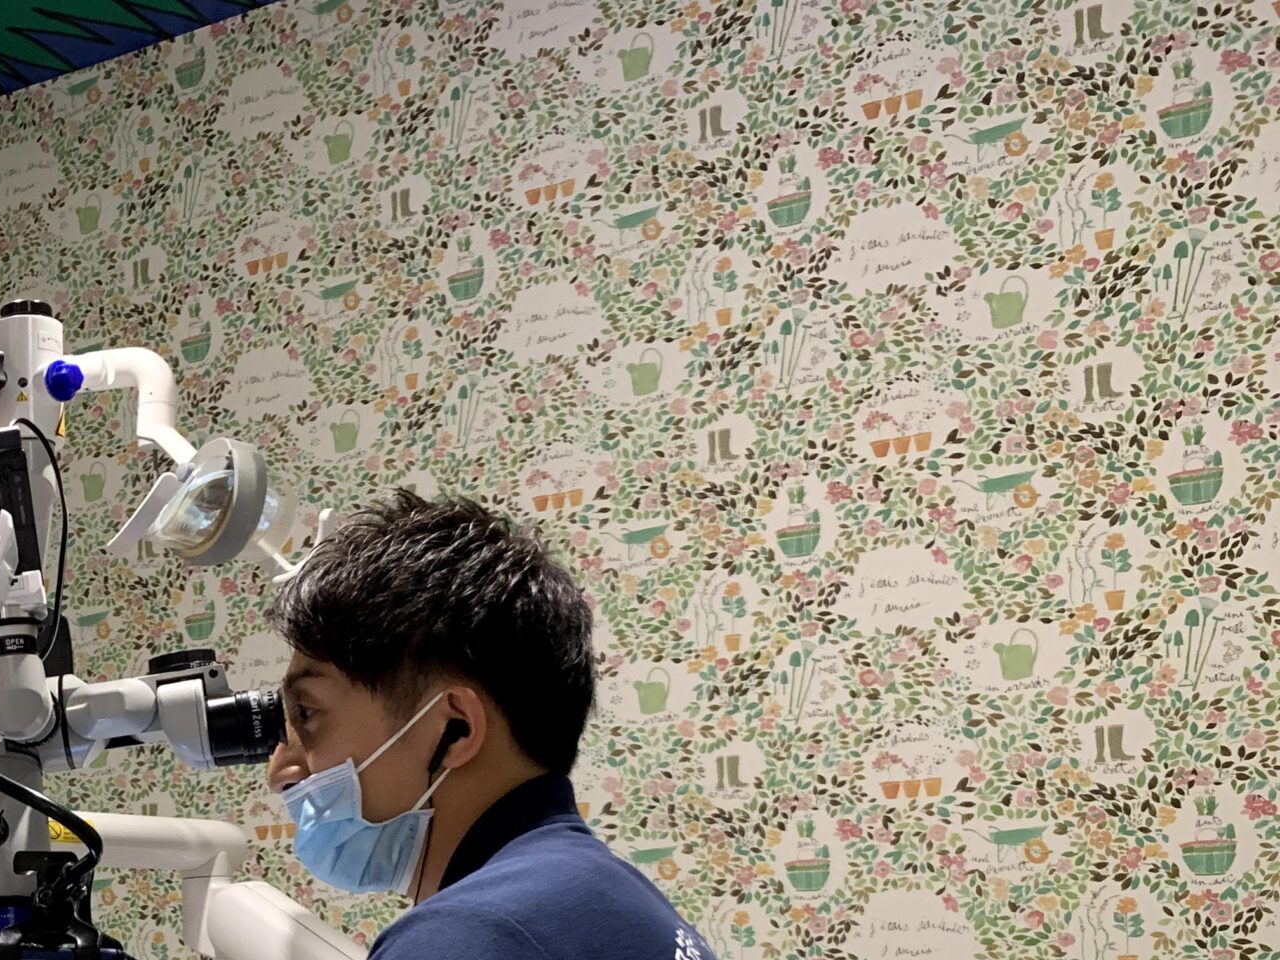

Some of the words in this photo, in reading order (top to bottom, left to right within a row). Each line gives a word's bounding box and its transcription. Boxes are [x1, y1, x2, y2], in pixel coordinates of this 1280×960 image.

[5, 637, 24, 646] OPEN
[249, 695, 261, 712] Carl
[252, 714, 263, 738] Zeiss
